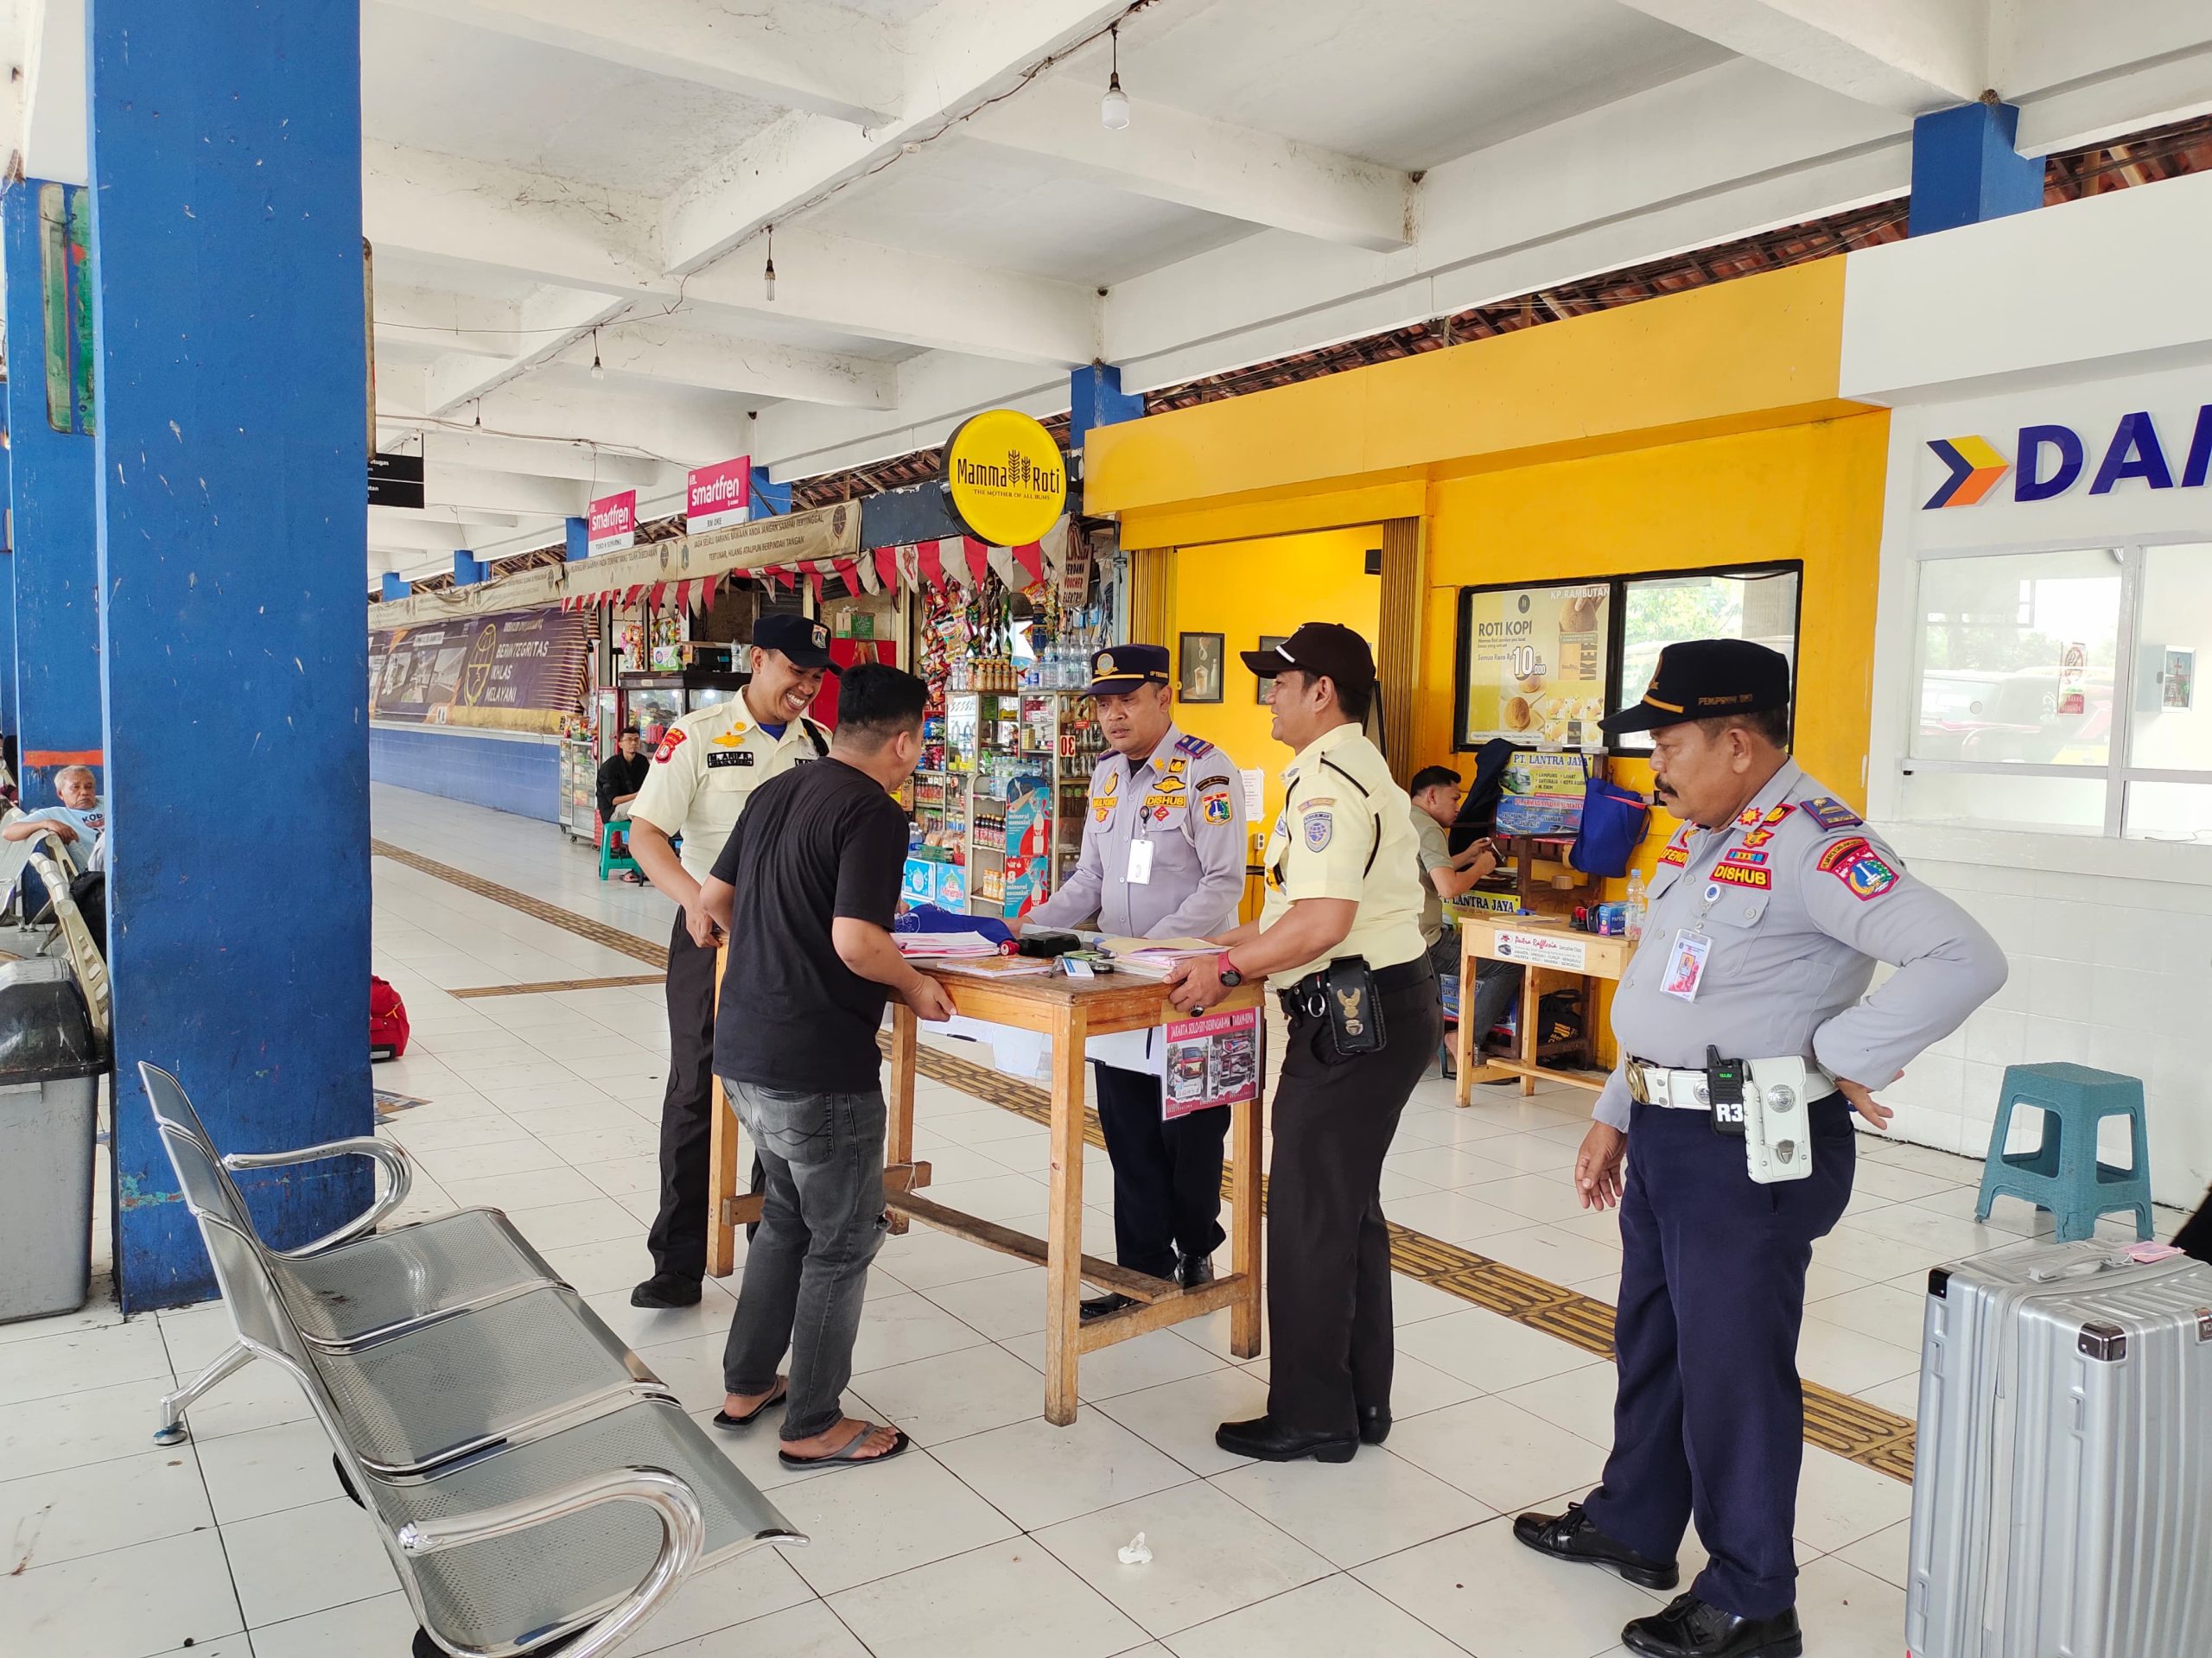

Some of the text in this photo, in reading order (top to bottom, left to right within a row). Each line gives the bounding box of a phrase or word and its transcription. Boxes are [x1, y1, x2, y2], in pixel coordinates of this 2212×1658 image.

[957, 459, 1059, 493] Mamma Roti
[691, 473, 740, 506] smartfren
[592, 504, 629, 530] smartfren
[715, 535, 729, 545] BARANG
[731, 530, 748, 542] BAWAAN
[749, 527, 760, 537] ANDA
[761, 524, 778, 535] JANGAN
[779, 520, 796, 532] SAMPAI
[728, 548, 743, 558] HILANG
[743, 544, 762, 556] ATAUPUN
[762, 540, 785, 552] BERPINDAH
[786, 536, 805, 547] TANGAN
[1564, 588, 1609, 599] RAMBUTAN
[1479, 620, 1532, 637] ROTI KOPI
[496, 641, 550, 658] BERINTEGRITAS
[491, 664, 513, 680] IKHLAS
[485, 687, 517, 702] MELAYANI
[1529, 755, 1564, 765] LANTRA
[1567, 757, 1588, 766] JAYA
[1147, 797, 1184, 805] DISHUB
[1007, 871, 1016, 883] 8
[1714, 866, 1766, 885] DISHUB
[1452, 895, 1490, 909] LANTRA
[1491, 899, 1514, 912] JAYA
[1516, 936, 1531, 945] Putra
[1533, 938, 1557, 949] Rafflesia
[1171, 1023, 1187, 1040] JAKARTA
[1716, 1104, 1744, 1121] R3
